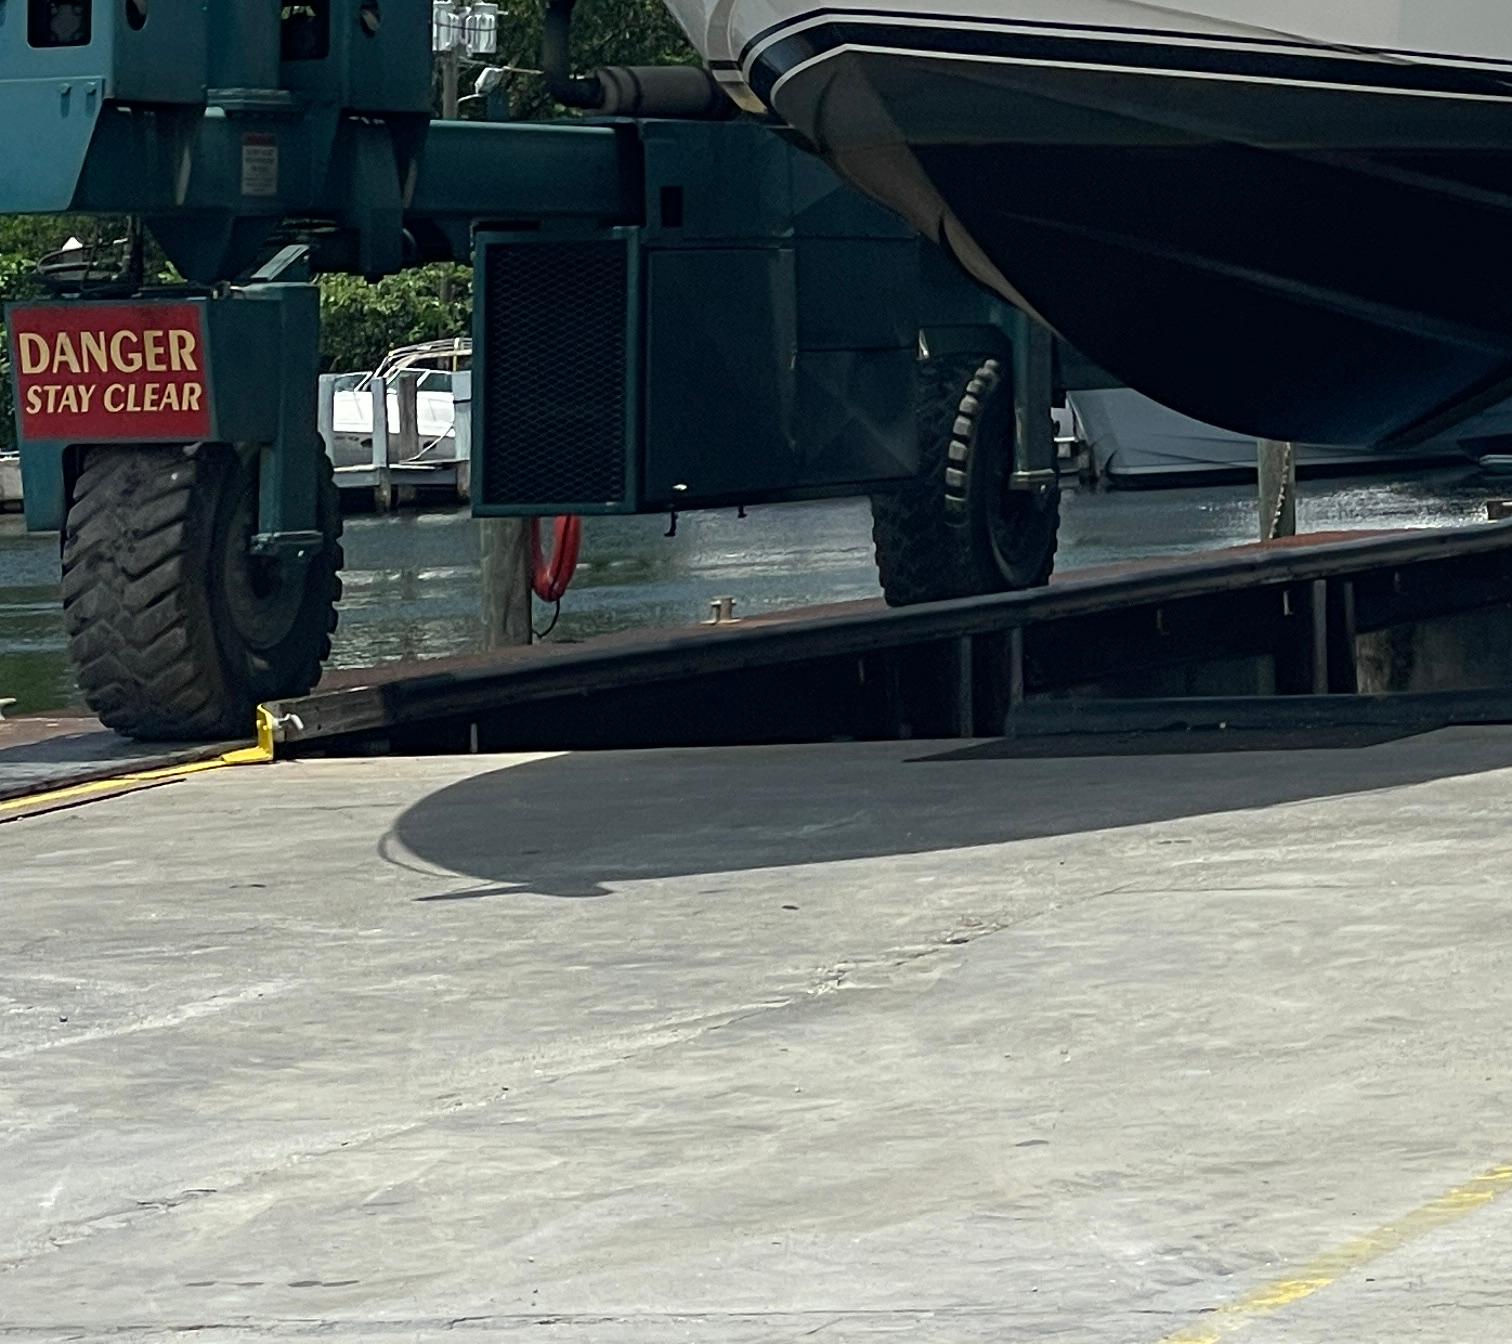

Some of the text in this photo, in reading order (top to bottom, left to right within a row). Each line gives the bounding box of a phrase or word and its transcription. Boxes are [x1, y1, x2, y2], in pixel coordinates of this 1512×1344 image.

[18, 329, 198, 375] DANGER
[25, 382, 203, 415] STAY CLEAR
